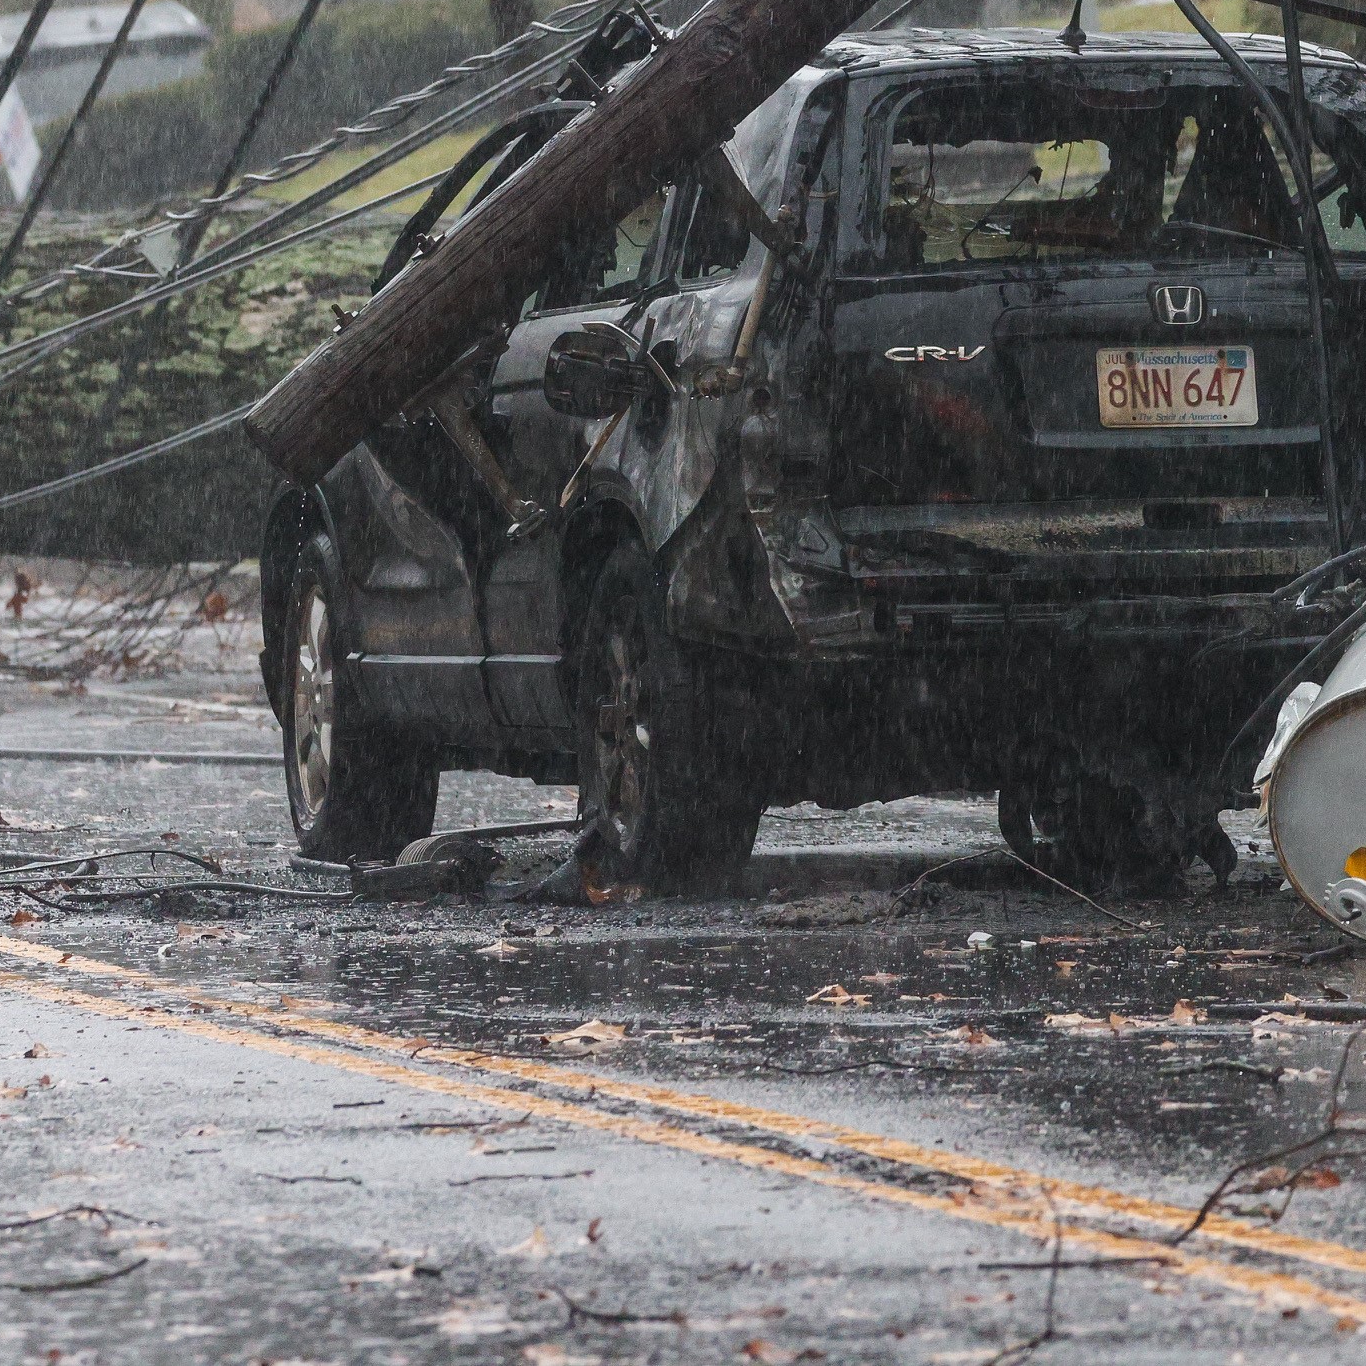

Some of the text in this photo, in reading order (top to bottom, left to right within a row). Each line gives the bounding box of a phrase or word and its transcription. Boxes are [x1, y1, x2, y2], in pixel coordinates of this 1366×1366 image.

[883, 344, 986, 362] CR-V
[1105, 354, 1125, 365] JUL
[1135, 351, 1218, 365] Massachusetts
[1107, 367, 1245, 408] 8NN 647
[1138, 412, 1222, 422] The Spirit of America
